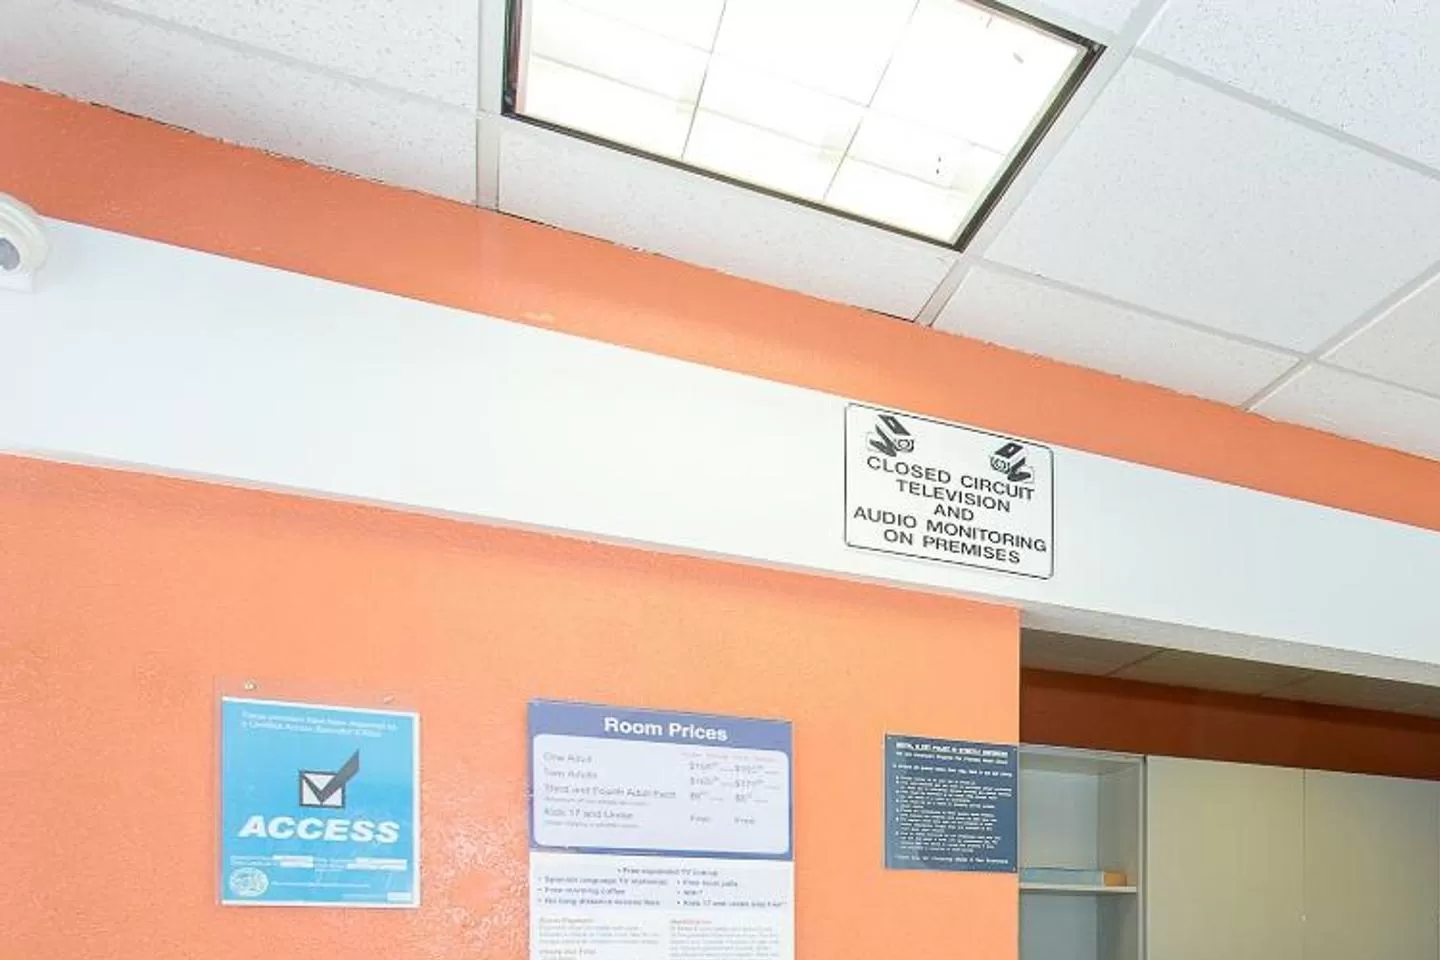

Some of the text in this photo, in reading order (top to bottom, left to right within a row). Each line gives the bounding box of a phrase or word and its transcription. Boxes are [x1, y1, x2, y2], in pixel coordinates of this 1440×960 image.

[867, 456, 1035, 500] CLOSED CIRCUIT
[896, 479, 1011, 513] TELEVISION
[933, 504, 974, 521] AND
[853, 506, 1047, 552] AUDIO MONITORING
[884, 529, 1021, 564] ON PREMISES
[604, 717, 728, 742] Room Prices
[238, 815, 400, 843] ACCESS
